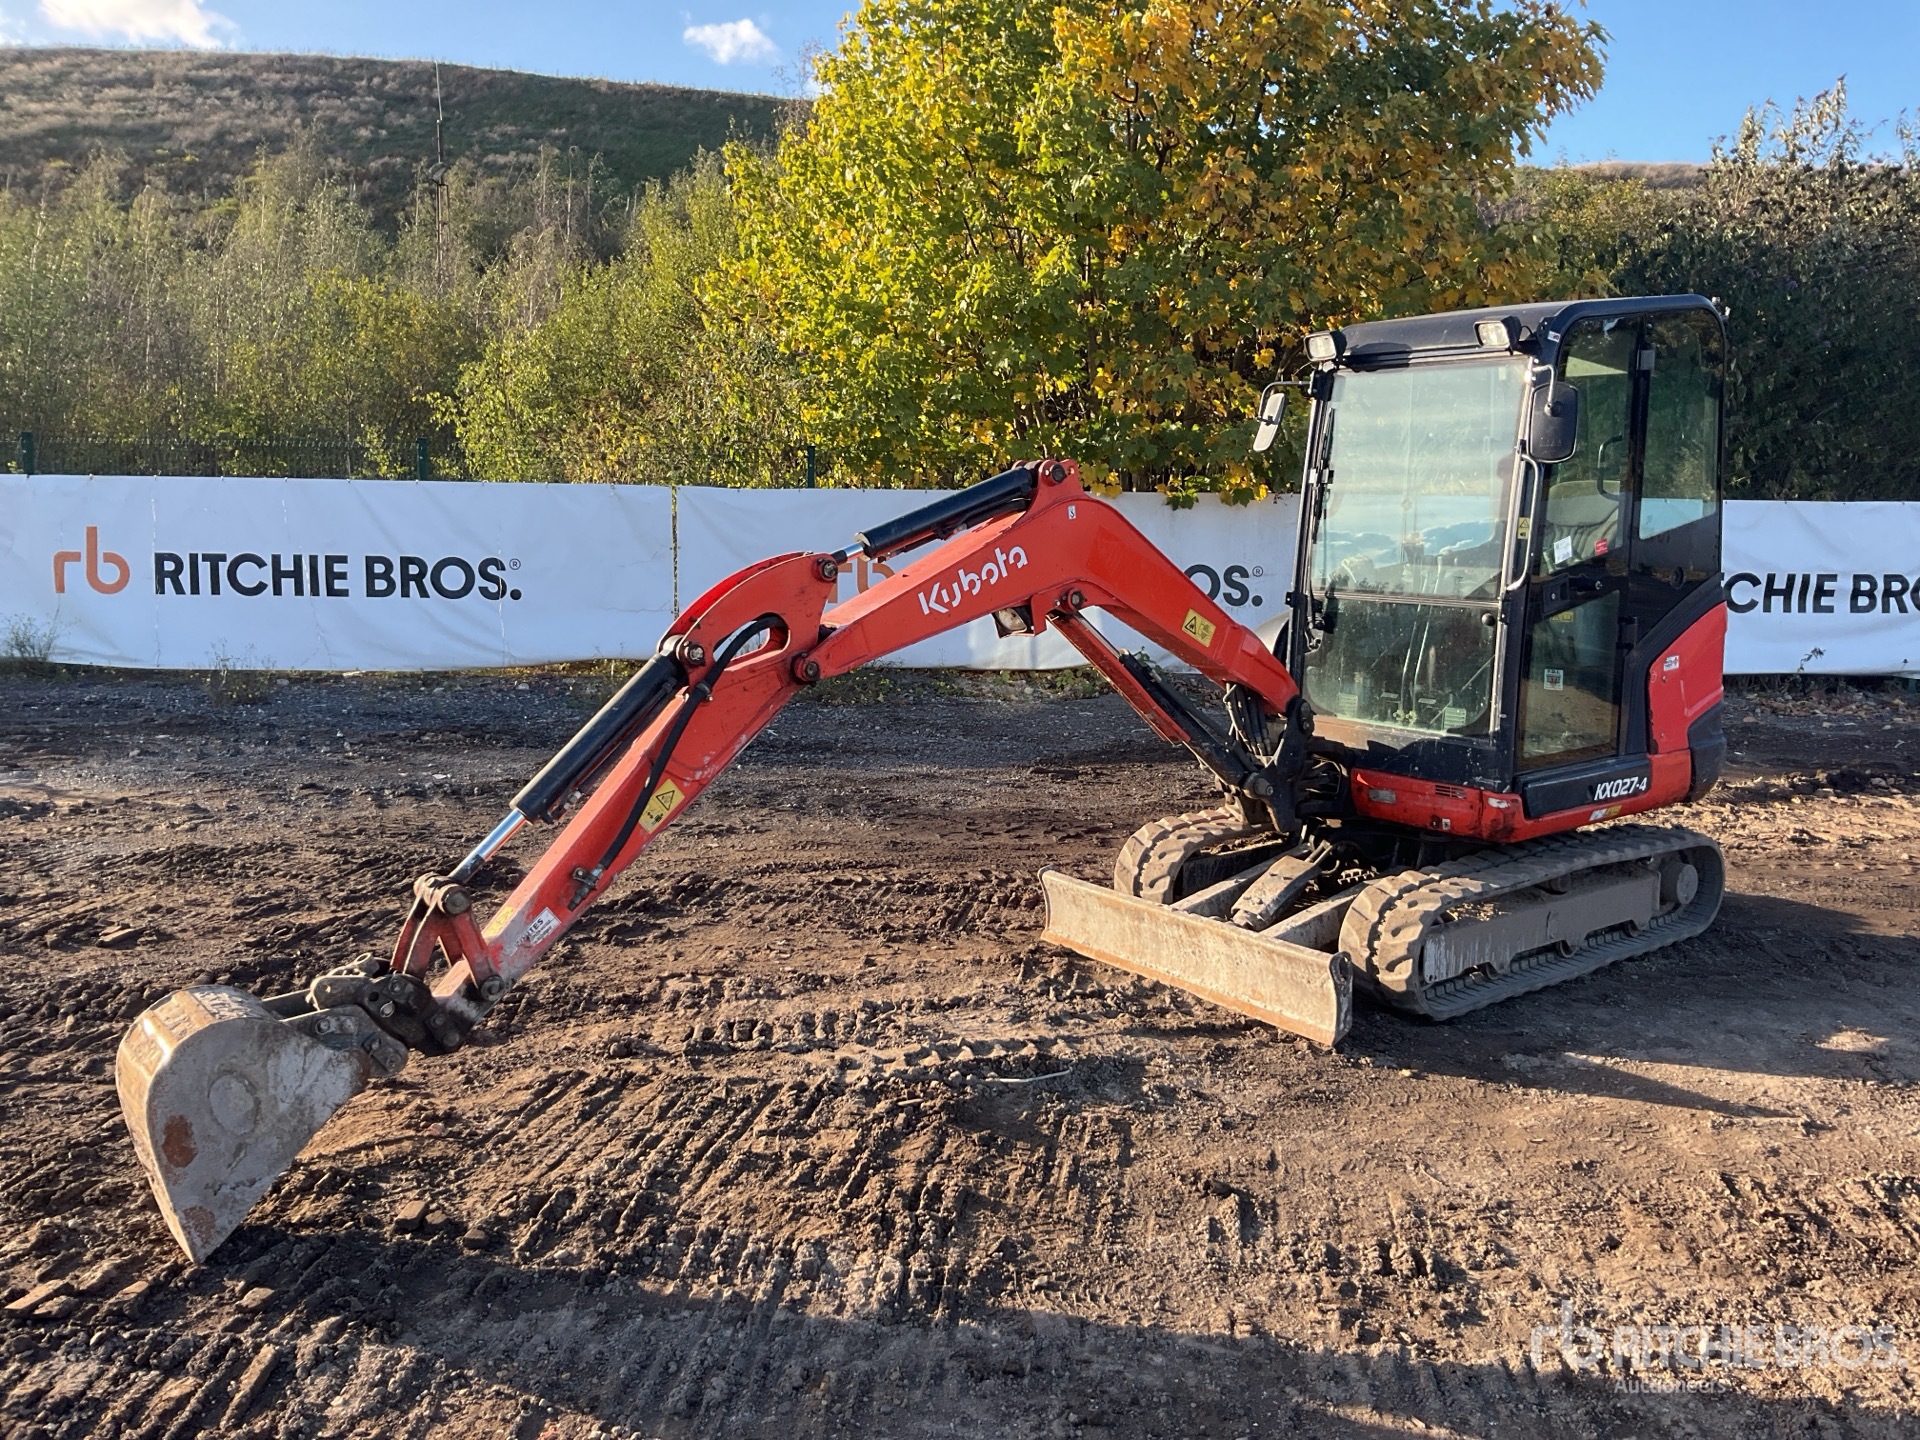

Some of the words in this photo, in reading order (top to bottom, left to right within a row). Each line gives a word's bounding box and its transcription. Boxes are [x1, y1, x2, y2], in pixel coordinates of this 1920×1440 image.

[154, 552, 350, 597] RITCHIE
[918, 546, 1028, 615] Kubota
[1721, 572, 1838, 614] CHIE
[1850, 573, 1920, 614] BR
